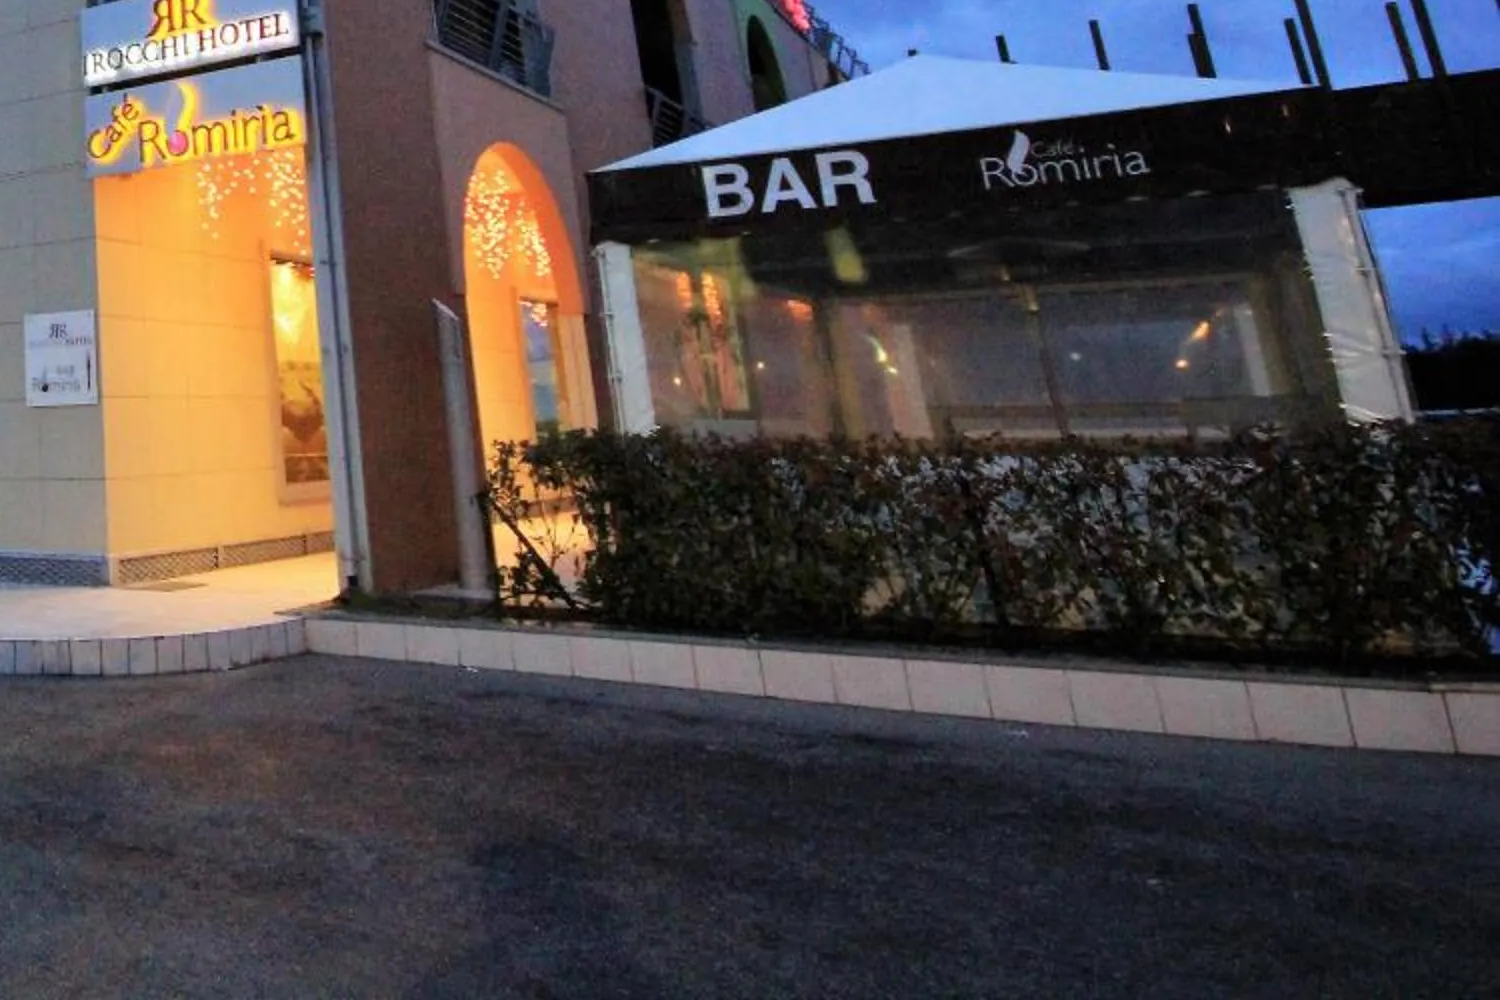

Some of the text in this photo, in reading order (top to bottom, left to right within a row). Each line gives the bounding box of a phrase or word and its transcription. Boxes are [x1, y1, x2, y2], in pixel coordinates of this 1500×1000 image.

[92, 33, 190, 73] ROCCHI
[197, 13, 289, 52] HOTEL
[88, 92, 295, 163] Café Romiria
[701, 150, 877, 219] BAR
[980, 143, 1151, 191] Romiria
